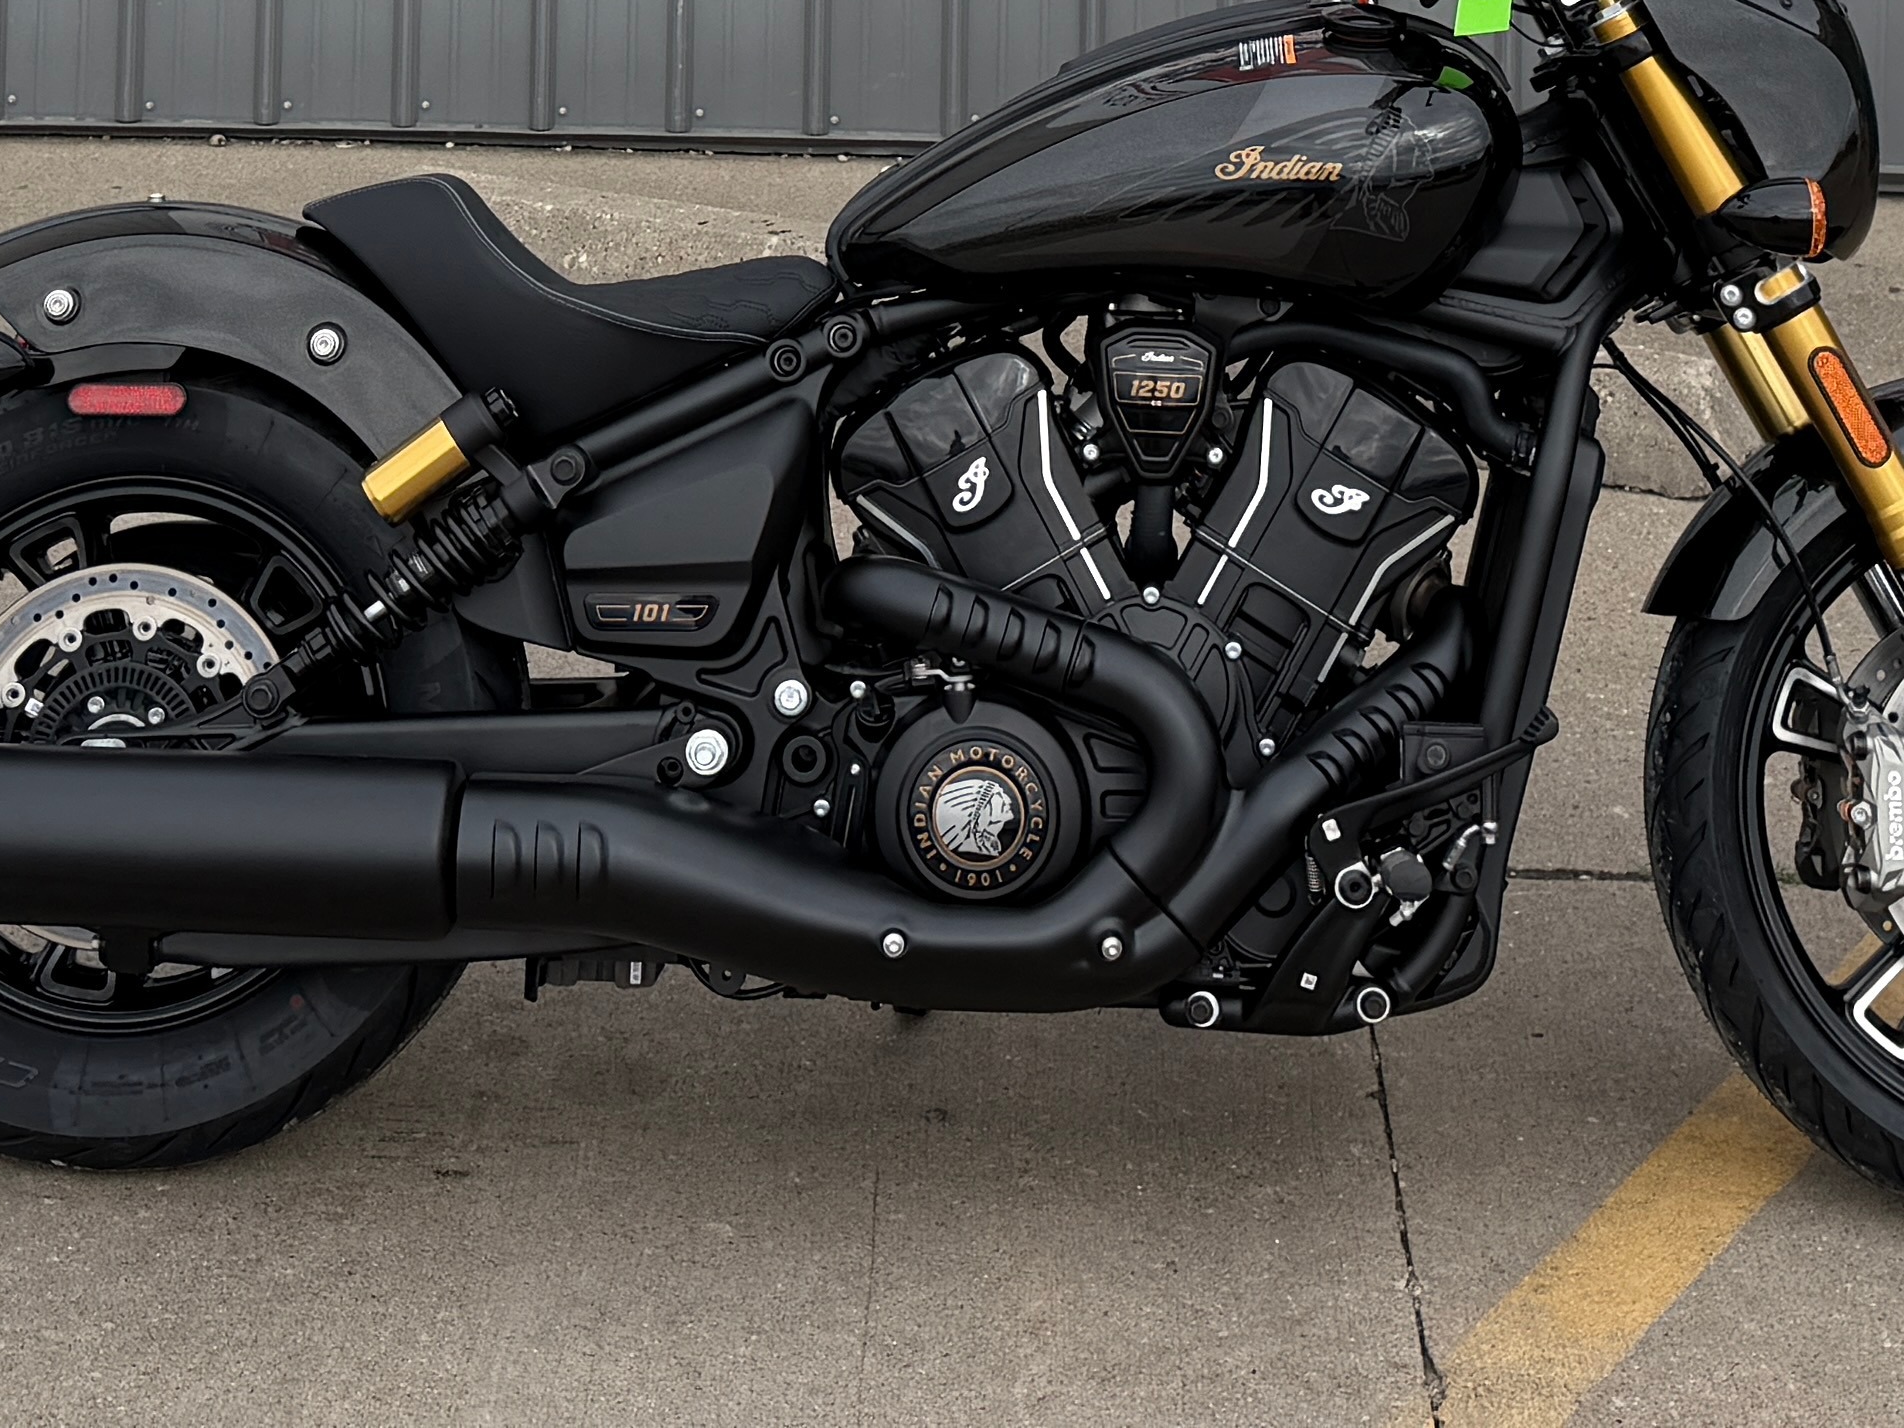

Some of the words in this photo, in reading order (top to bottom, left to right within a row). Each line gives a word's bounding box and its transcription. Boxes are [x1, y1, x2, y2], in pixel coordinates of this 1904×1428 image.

[1214, 145, 1344, 181] Indian
[1130, 379, 1186, 399] 1250
[633, 603, 671, 622] 101
[913, 765, 943, 859] INDIAN
[949, 746, 1044, 861] MOTORCYCLE
[1883, 770, 1904, 861] brembo
[954, 869, 1004, 887] 1901
